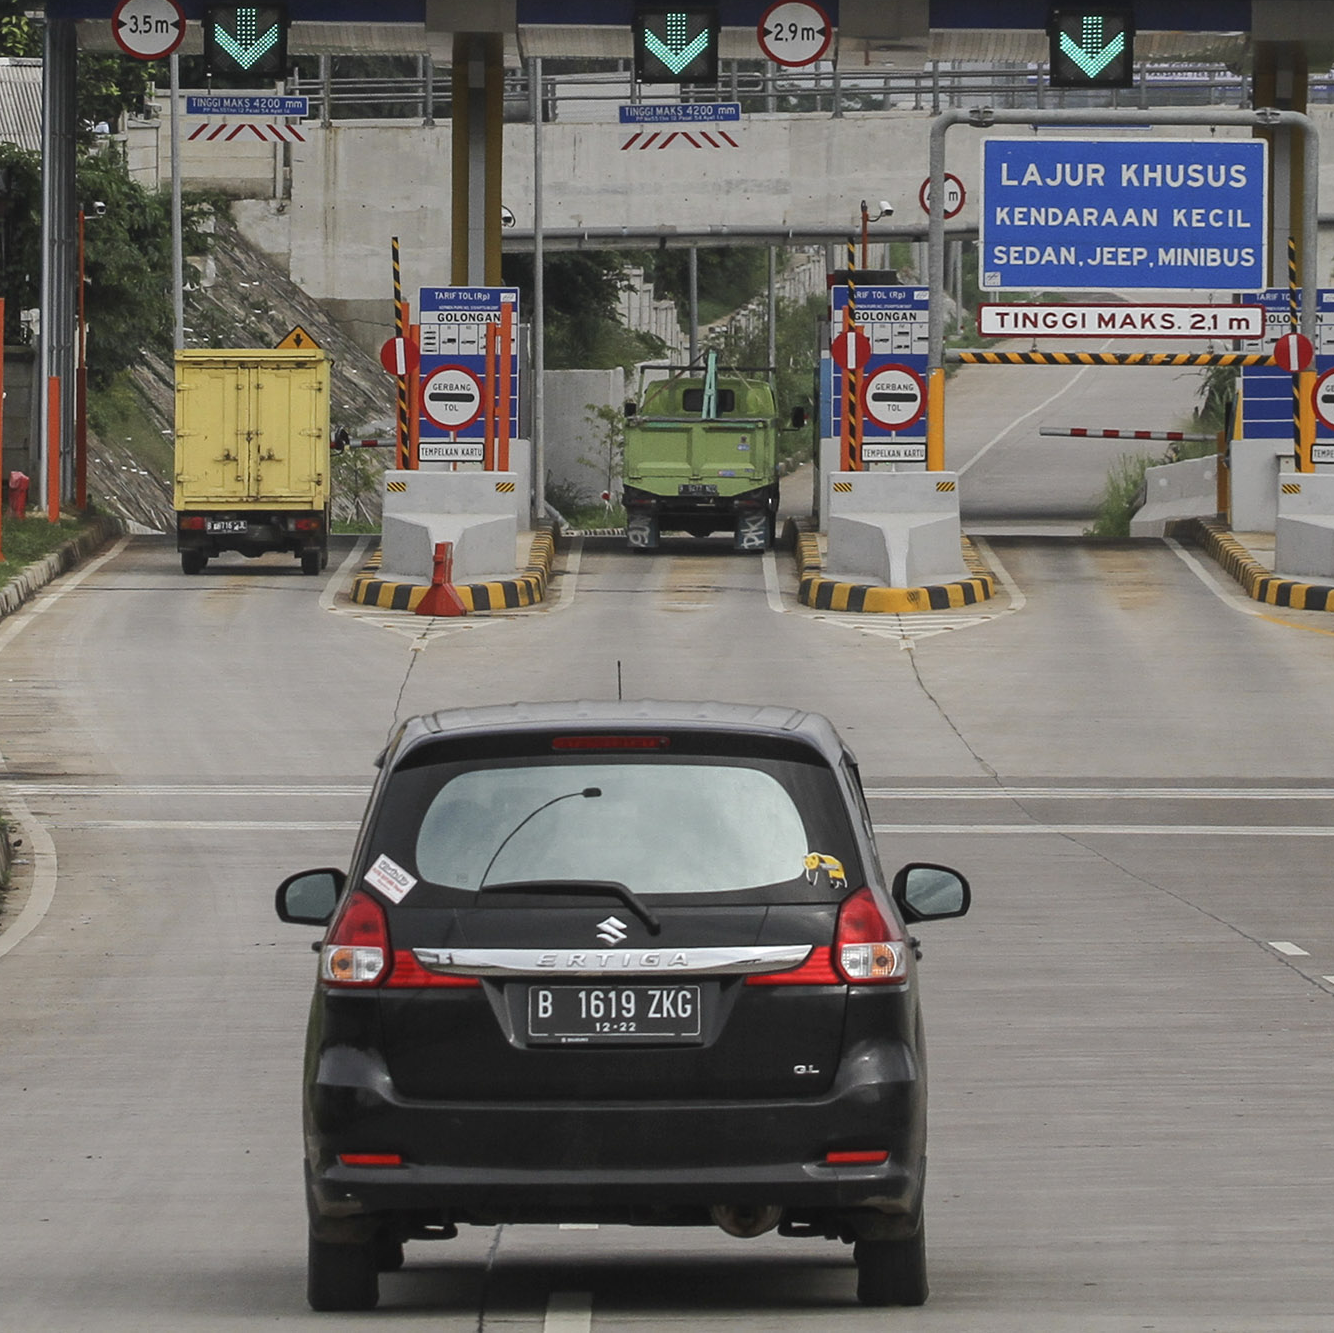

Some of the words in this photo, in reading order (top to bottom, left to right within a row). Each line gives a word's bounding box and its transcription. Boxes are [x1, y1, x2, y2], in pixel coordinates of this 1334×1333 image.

[191, 97, 221, 107] TINGGI
[223, 97, 250, 107] MAKS
[253, 98, 280, 108] 4200
[285, 100, 303, 108] mm
[625, 107, 653, 116] TINGGI
[656, 106, 683, 115] MAKS
[686, 106, 713, 115] 4200
[1001, 163, 1105, 186] LAJUR
[1121, 163, 1247, 188] KHUSUS
[995, 207, 1158, 227] KENDARAAN
[1173, 208, 1251, 228] KECIL
[1158, 248, 1255, 267] MINIBUS
[435, 291, 457, 300] TARIF
[872, 291, 886, 299] TOL
[889, 291, 906, 300] (Rp)
[1256, 293, 1279, 301] TARIF
[437, 312, 501, 322] GOLONGAN
[854, 312, 917, 321] GOLONGAN
[995, 312, 1086, 330] TINGGI
[1097, 312, 1181, 331] MAKS.
[1190, 313, 1218, 332] 2,1
[1229, 317, 1250, 331] m
[432, 383, 471, 392] GERBANG
[875, 383, 914, 391] GERBANG
[421, 447, 459, 456] TEMPELKAN
[461, 447, 482, 457] KARTU
[863, 449, 901, 457] TEMPELKAN
[903, 449, 924, 457] KARTU
[536, 952, 688, 967] ERTIGA
[538, 990, 553, 1018] B
[578, 990, 636, 1018] 1619
[647, 990, 692, 1018] ZKG
[794, 1065, 819, 1074] GL
